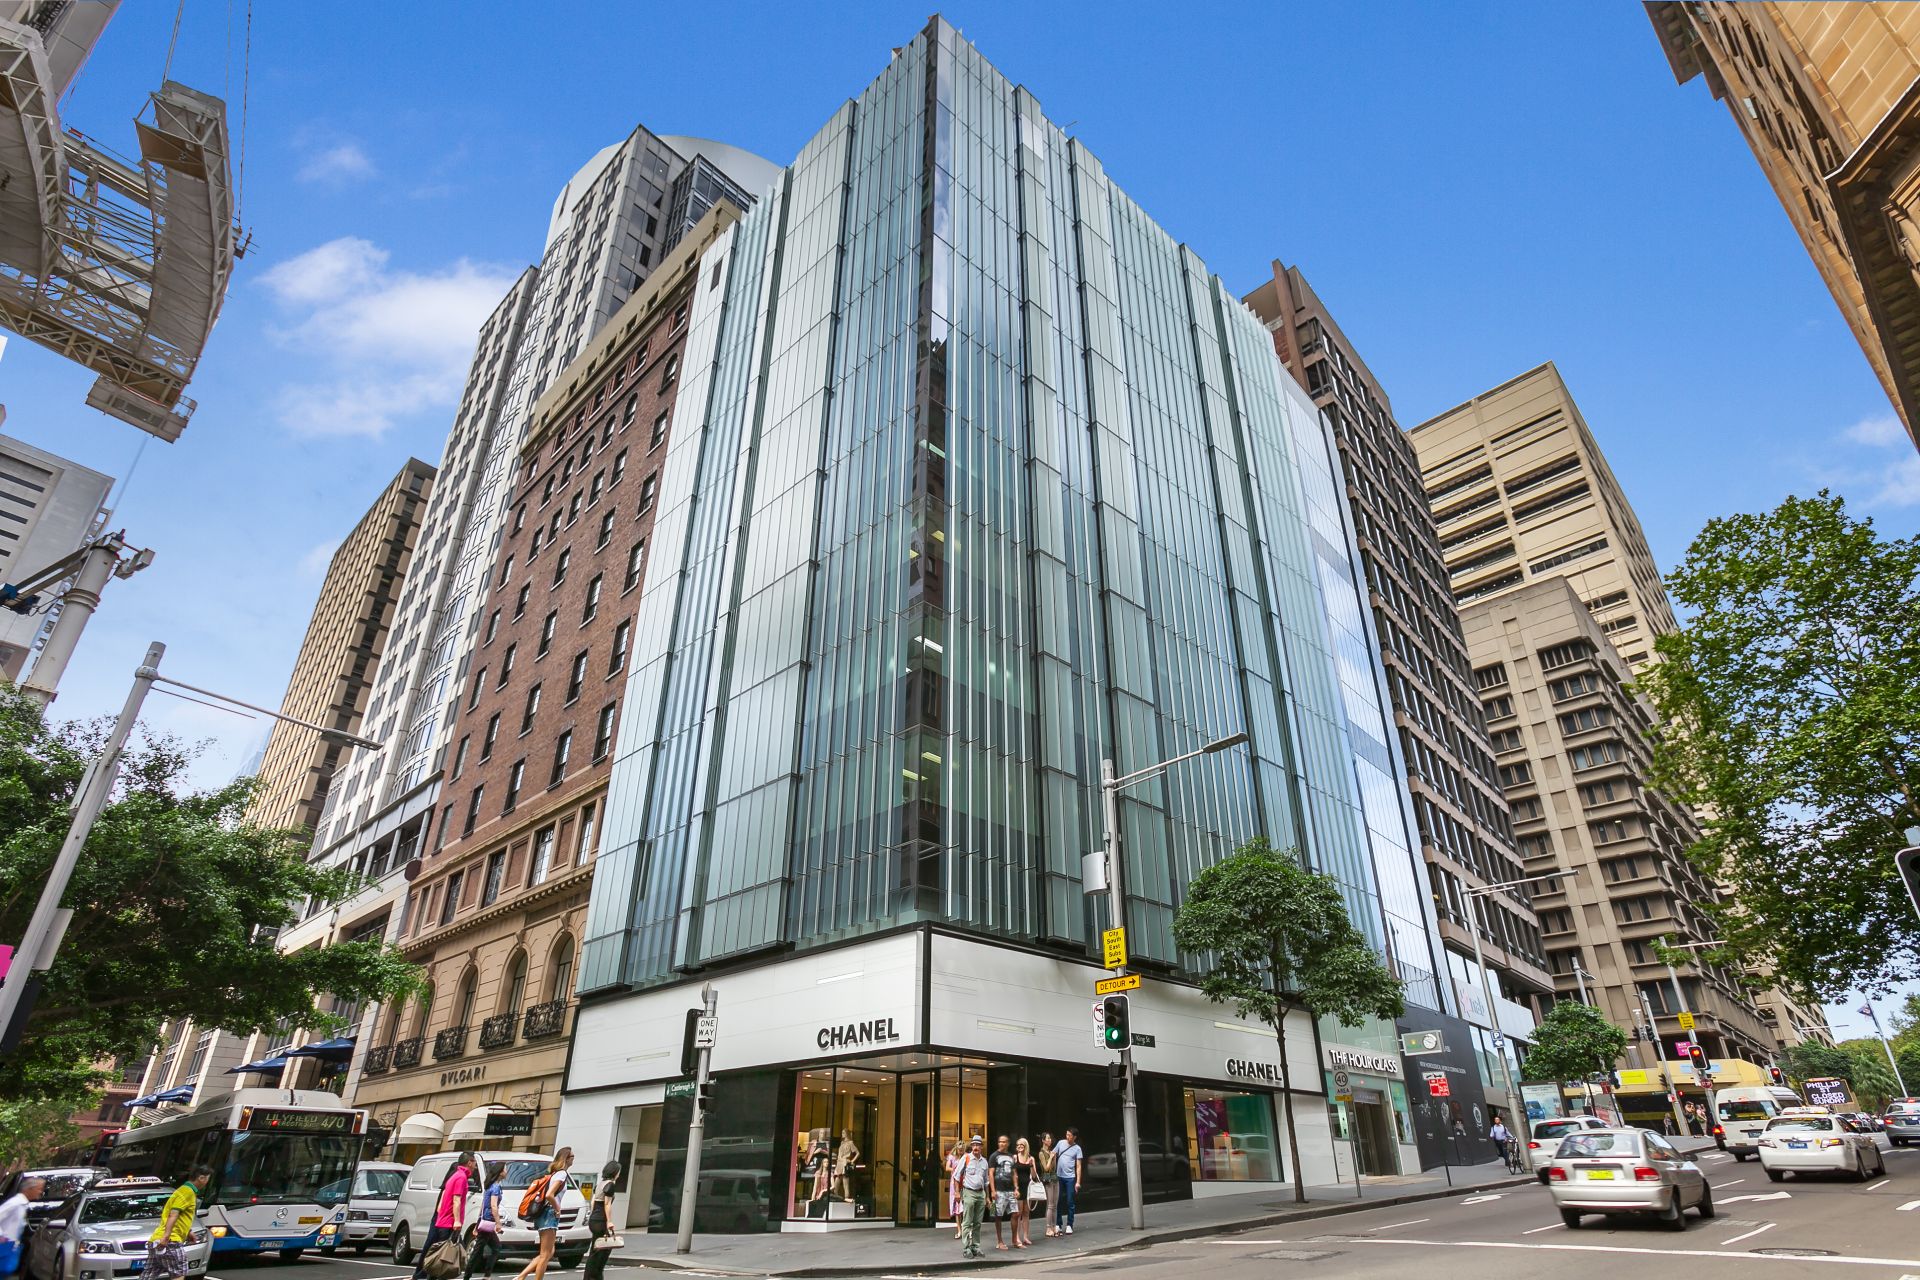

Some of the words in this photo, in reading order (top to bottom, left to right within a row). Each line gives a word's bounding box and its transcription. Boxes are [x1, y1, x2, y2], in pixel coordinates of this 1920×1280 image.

[1100, 979, 1126, 991] DETOUR
[700, 1019, 715, 1027] ONE
[817, 1018, 899, 1048] CHANEL
[1329, 1049, 1348, 1064] THE
[1347, 1052, 1373, 1069] HOUR
[1372, 1057, 1398, 1073] GLASS
[440, 1065, 487, 1087] BVLGARI
[1226, 1058, 1282, 1081] CHANEL
[1336, 1074, 1347, 1084] 40
[1806, 1081, 1840, 1089] PHILLIP
[265, 1113, 319, 1122] LILYFIELD
[320, 1116, 345, 1128] 470
